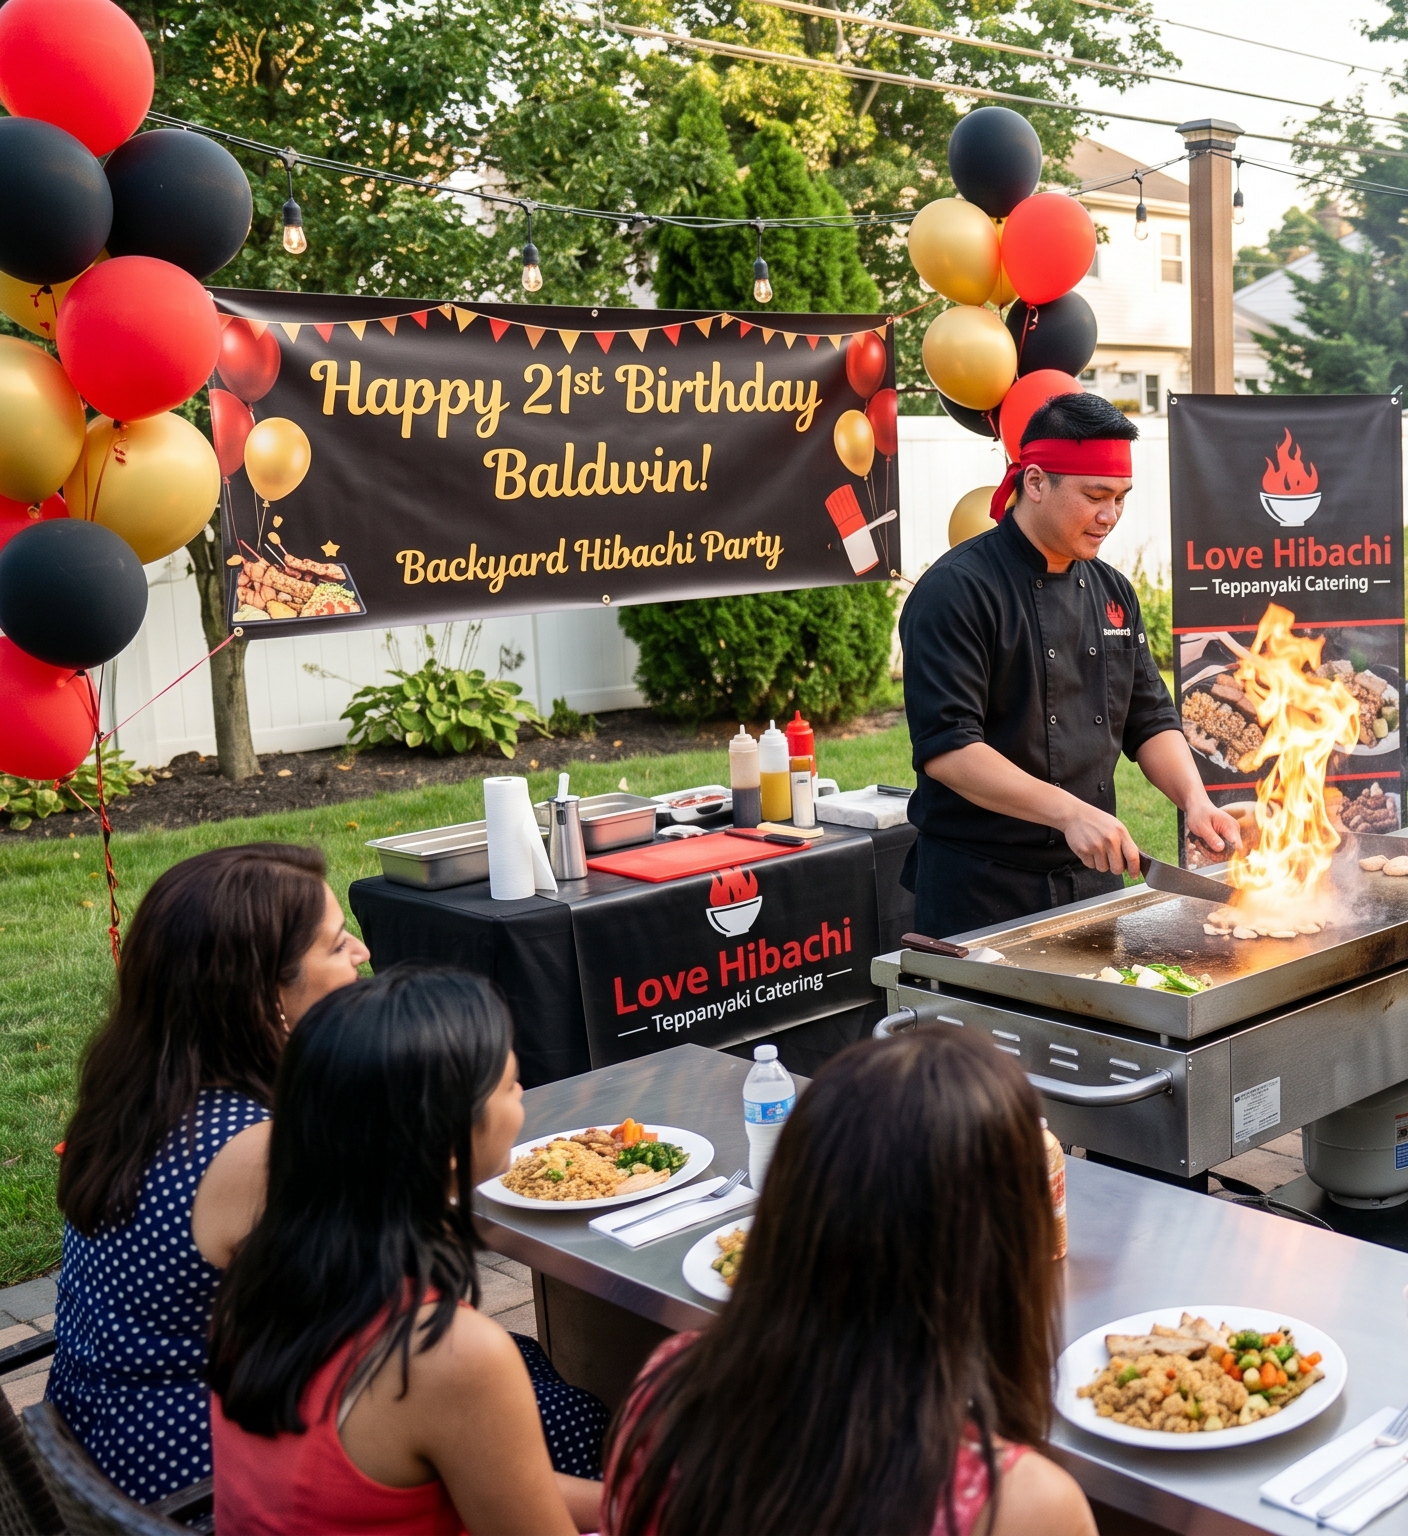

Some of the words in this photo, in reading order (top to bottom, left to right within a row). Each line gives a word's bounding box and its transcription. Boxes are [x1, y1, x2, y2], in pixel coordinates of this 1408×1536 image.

[309, 359, 511, 439] Happy
[522, 363, 605, 415] 21st
[614, 360, 823, 433] Birthday
[482, 441, 712, 500] Baldwin!
[395, 537, 568, 594] Backyard
[573, 530, 697, 572] Hibachi
[700, 530, 785, 571] Party
[1186, 539, 1264, 571] Love
[1273, 534, 1392, 569] Hibachi
[1211, 575, 1301, 598] Teppanyaki
[1304, 574, 1369, 594] Catering
[613, 965, 709, 1016] Love
[718, 916, 853, 987] Hibachi
[651, 991, 751, 1033] Teppanyaki
[756, 973, 824, 1003] Catering
